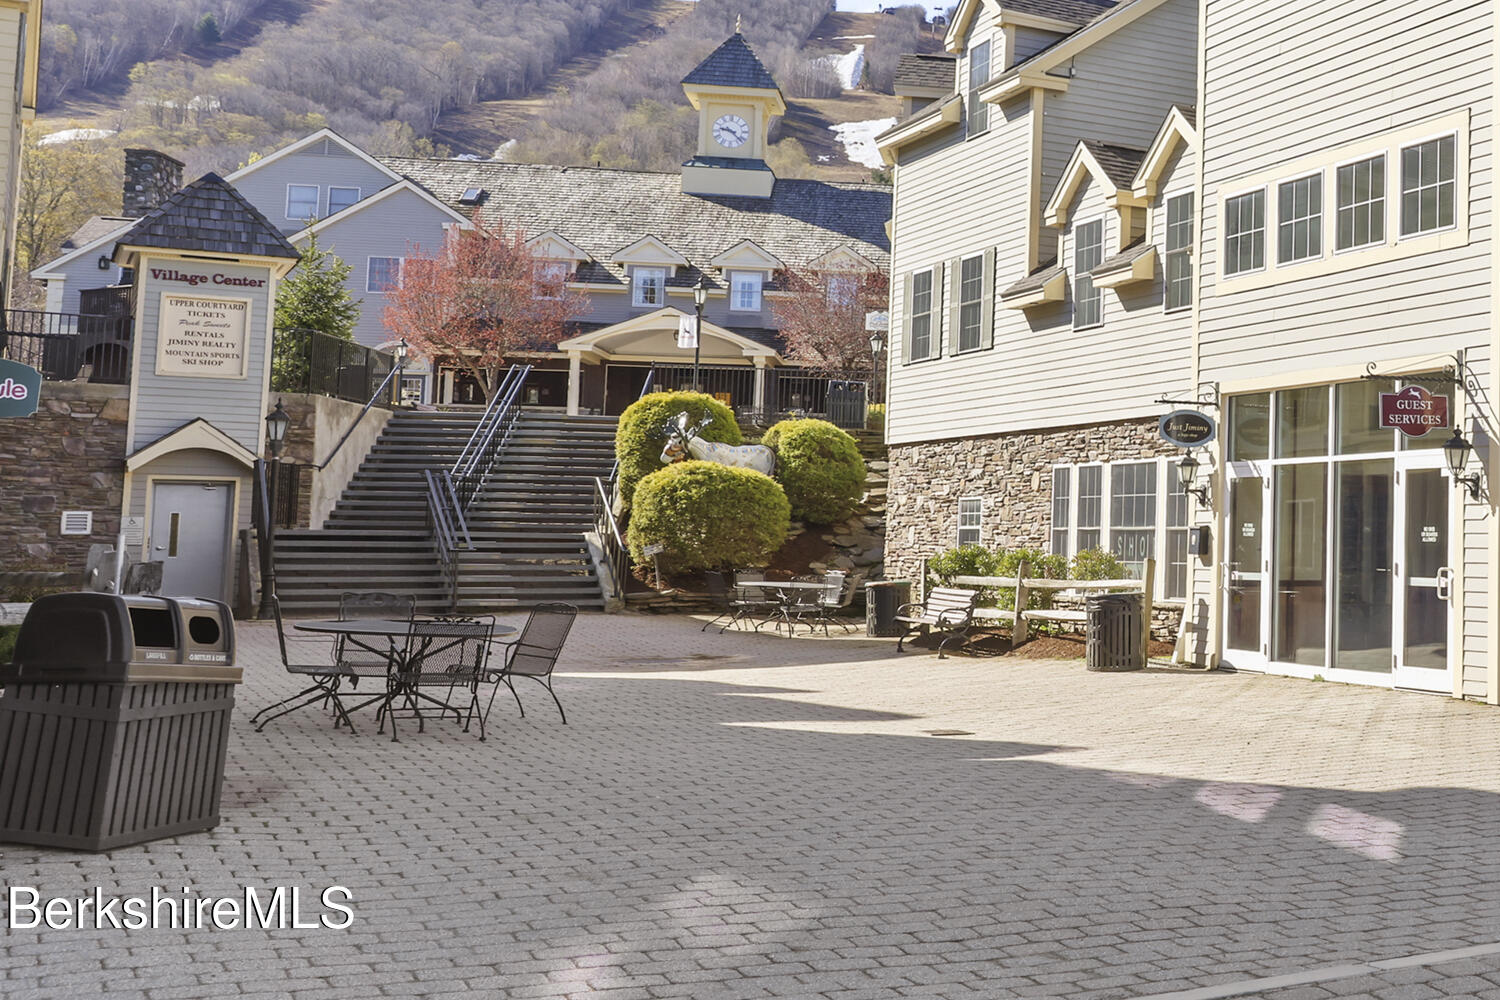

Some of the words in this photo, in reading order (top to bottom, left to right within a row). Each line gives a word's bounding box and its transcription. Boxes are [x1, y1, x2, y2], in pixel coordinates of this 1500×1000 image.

[151, 268, 209, 286] Village
[212, 273, 266, 288] Center
[169, 299, 195, 308] UPPER
[196, 301, 244, 311] COURTYARD
[187, 310, 226, 319] TICKETS
[184, 330, 225, 339] RENTALS
[167, 338, 200, 347] JIMINY
[202, 340, 237, 349] REALTY
[165, 349, 209, 358] MOUNTAIN
[210, 352, 240, 360] SPORTS
[182, 358, 197, 366] SKI
[1396, 399, 1433, 410] GUEST
[1388, 413, 1441, 425] SERVICES
[1167, 422, 1183, 432] Just
[1183, 422, 1209, 434] Jiminy
[1117, 535, 1156, 558] SHO
